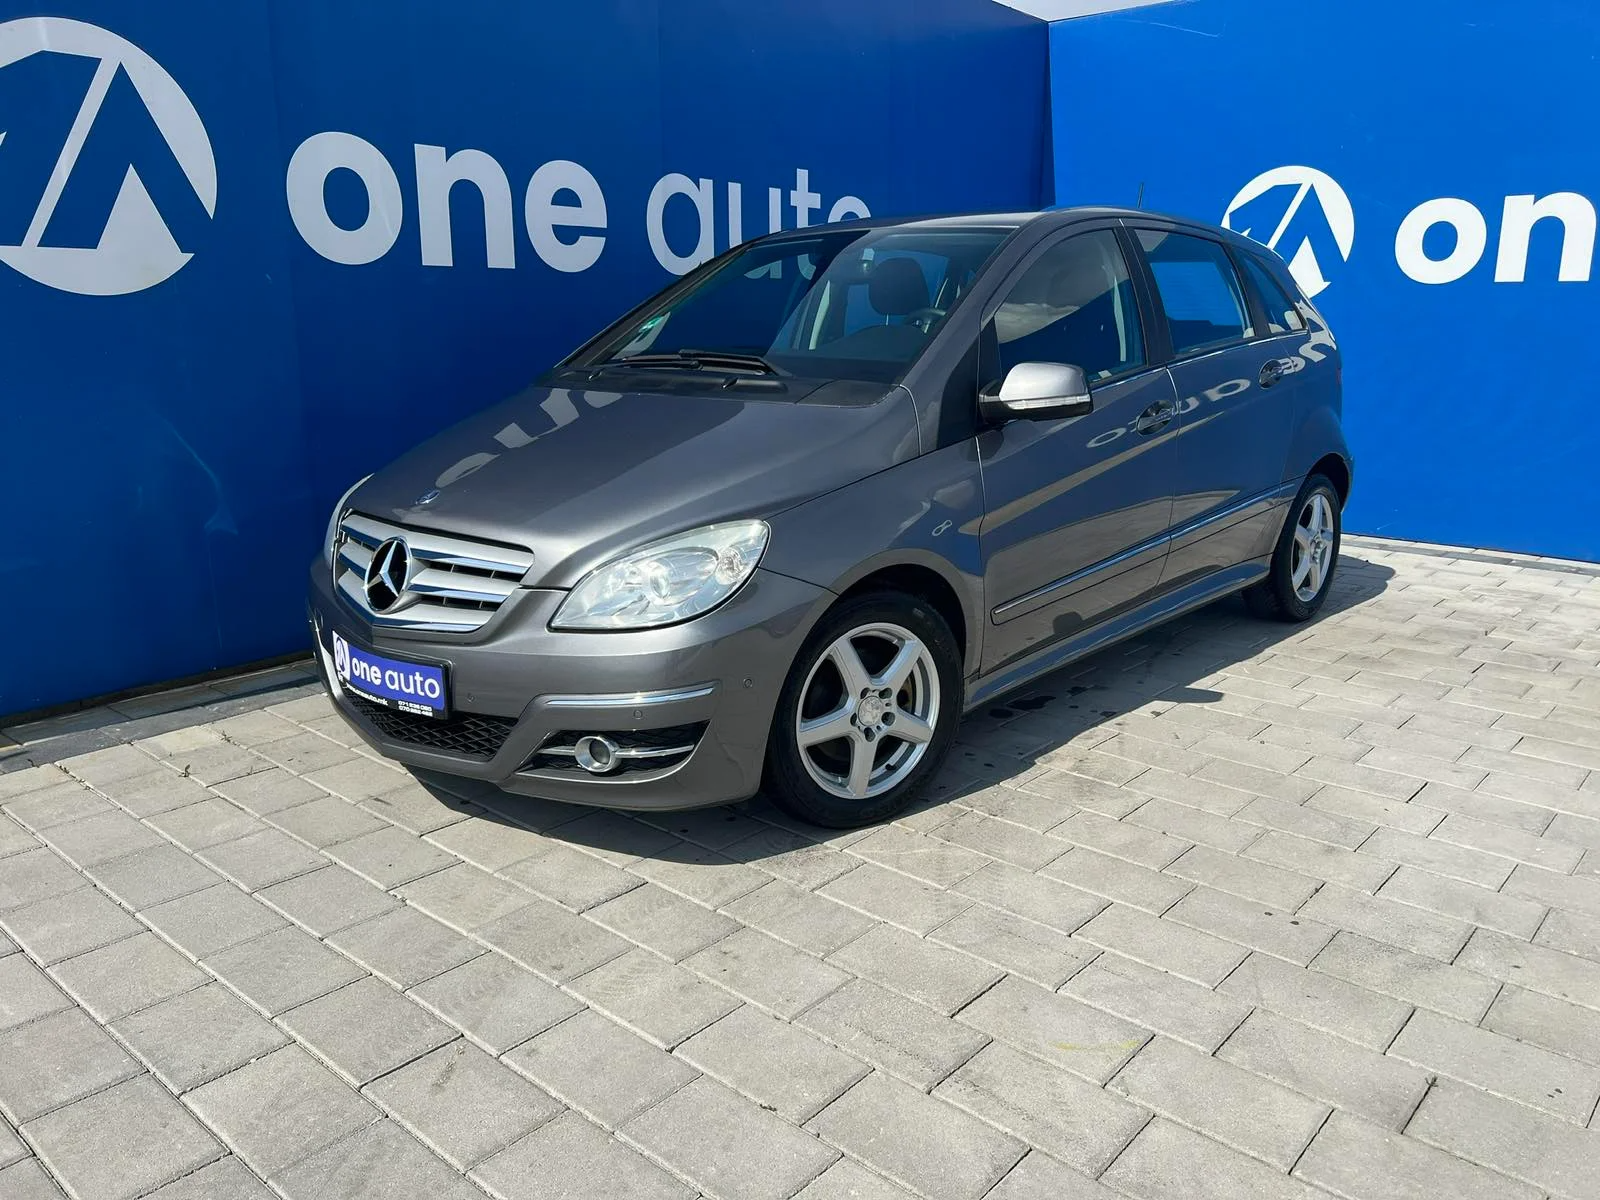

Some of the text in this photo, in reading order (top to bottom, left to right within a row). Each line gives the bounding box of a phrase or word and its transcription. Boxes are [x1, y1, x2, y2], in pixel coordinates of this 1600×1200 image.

[286, 131, 607, 273] one
[1394, 191, 1597, 285] on
[352, 657, 382, 686] one
[385, 669, 440, 699] auto
